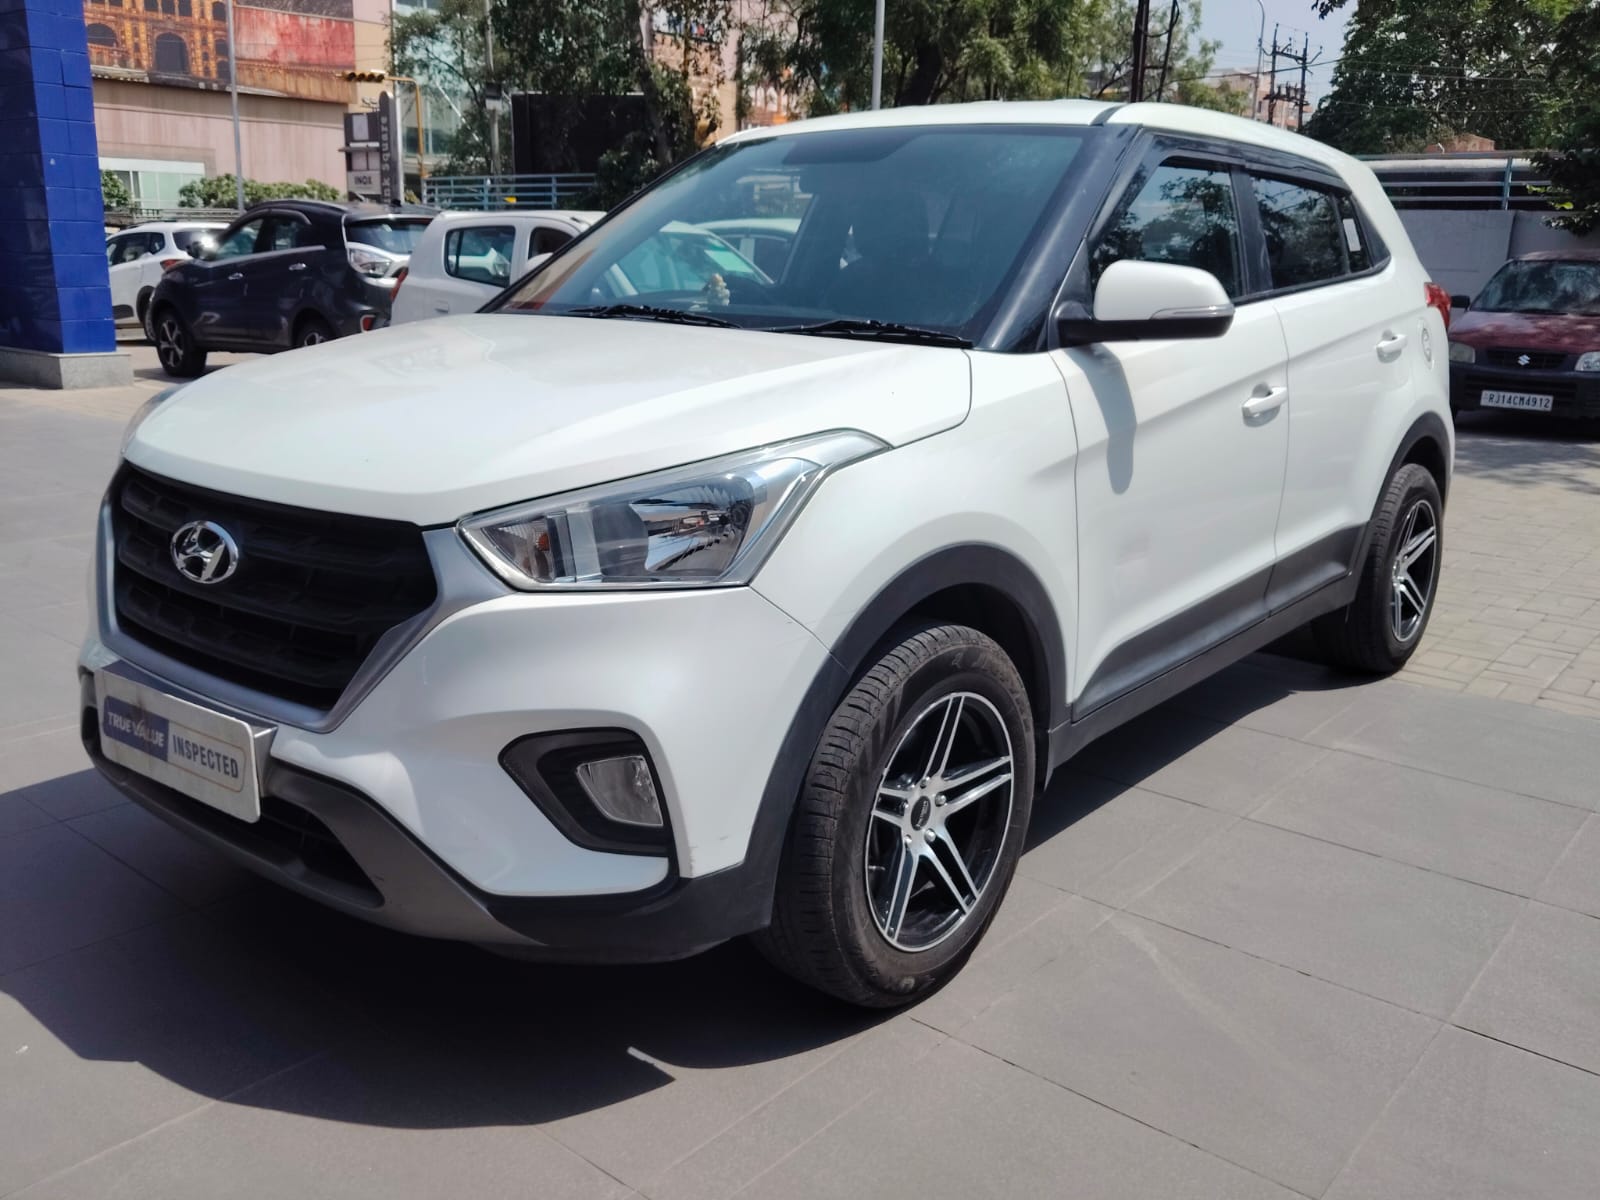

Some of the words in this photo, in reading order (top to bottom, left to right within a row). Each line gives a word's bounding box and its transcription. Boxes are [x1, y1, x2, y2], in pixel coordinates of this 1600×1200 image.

[380, 116, 391, 171] Square
[382, 178, 392, 203] ink
[1488, 393, 1551, 408] RJ14CM4912
[107, 711, 132, 733] TRUE
[132, 718, 165, 748] VALUE
[172, 735, 239, 779] INSPECTED
